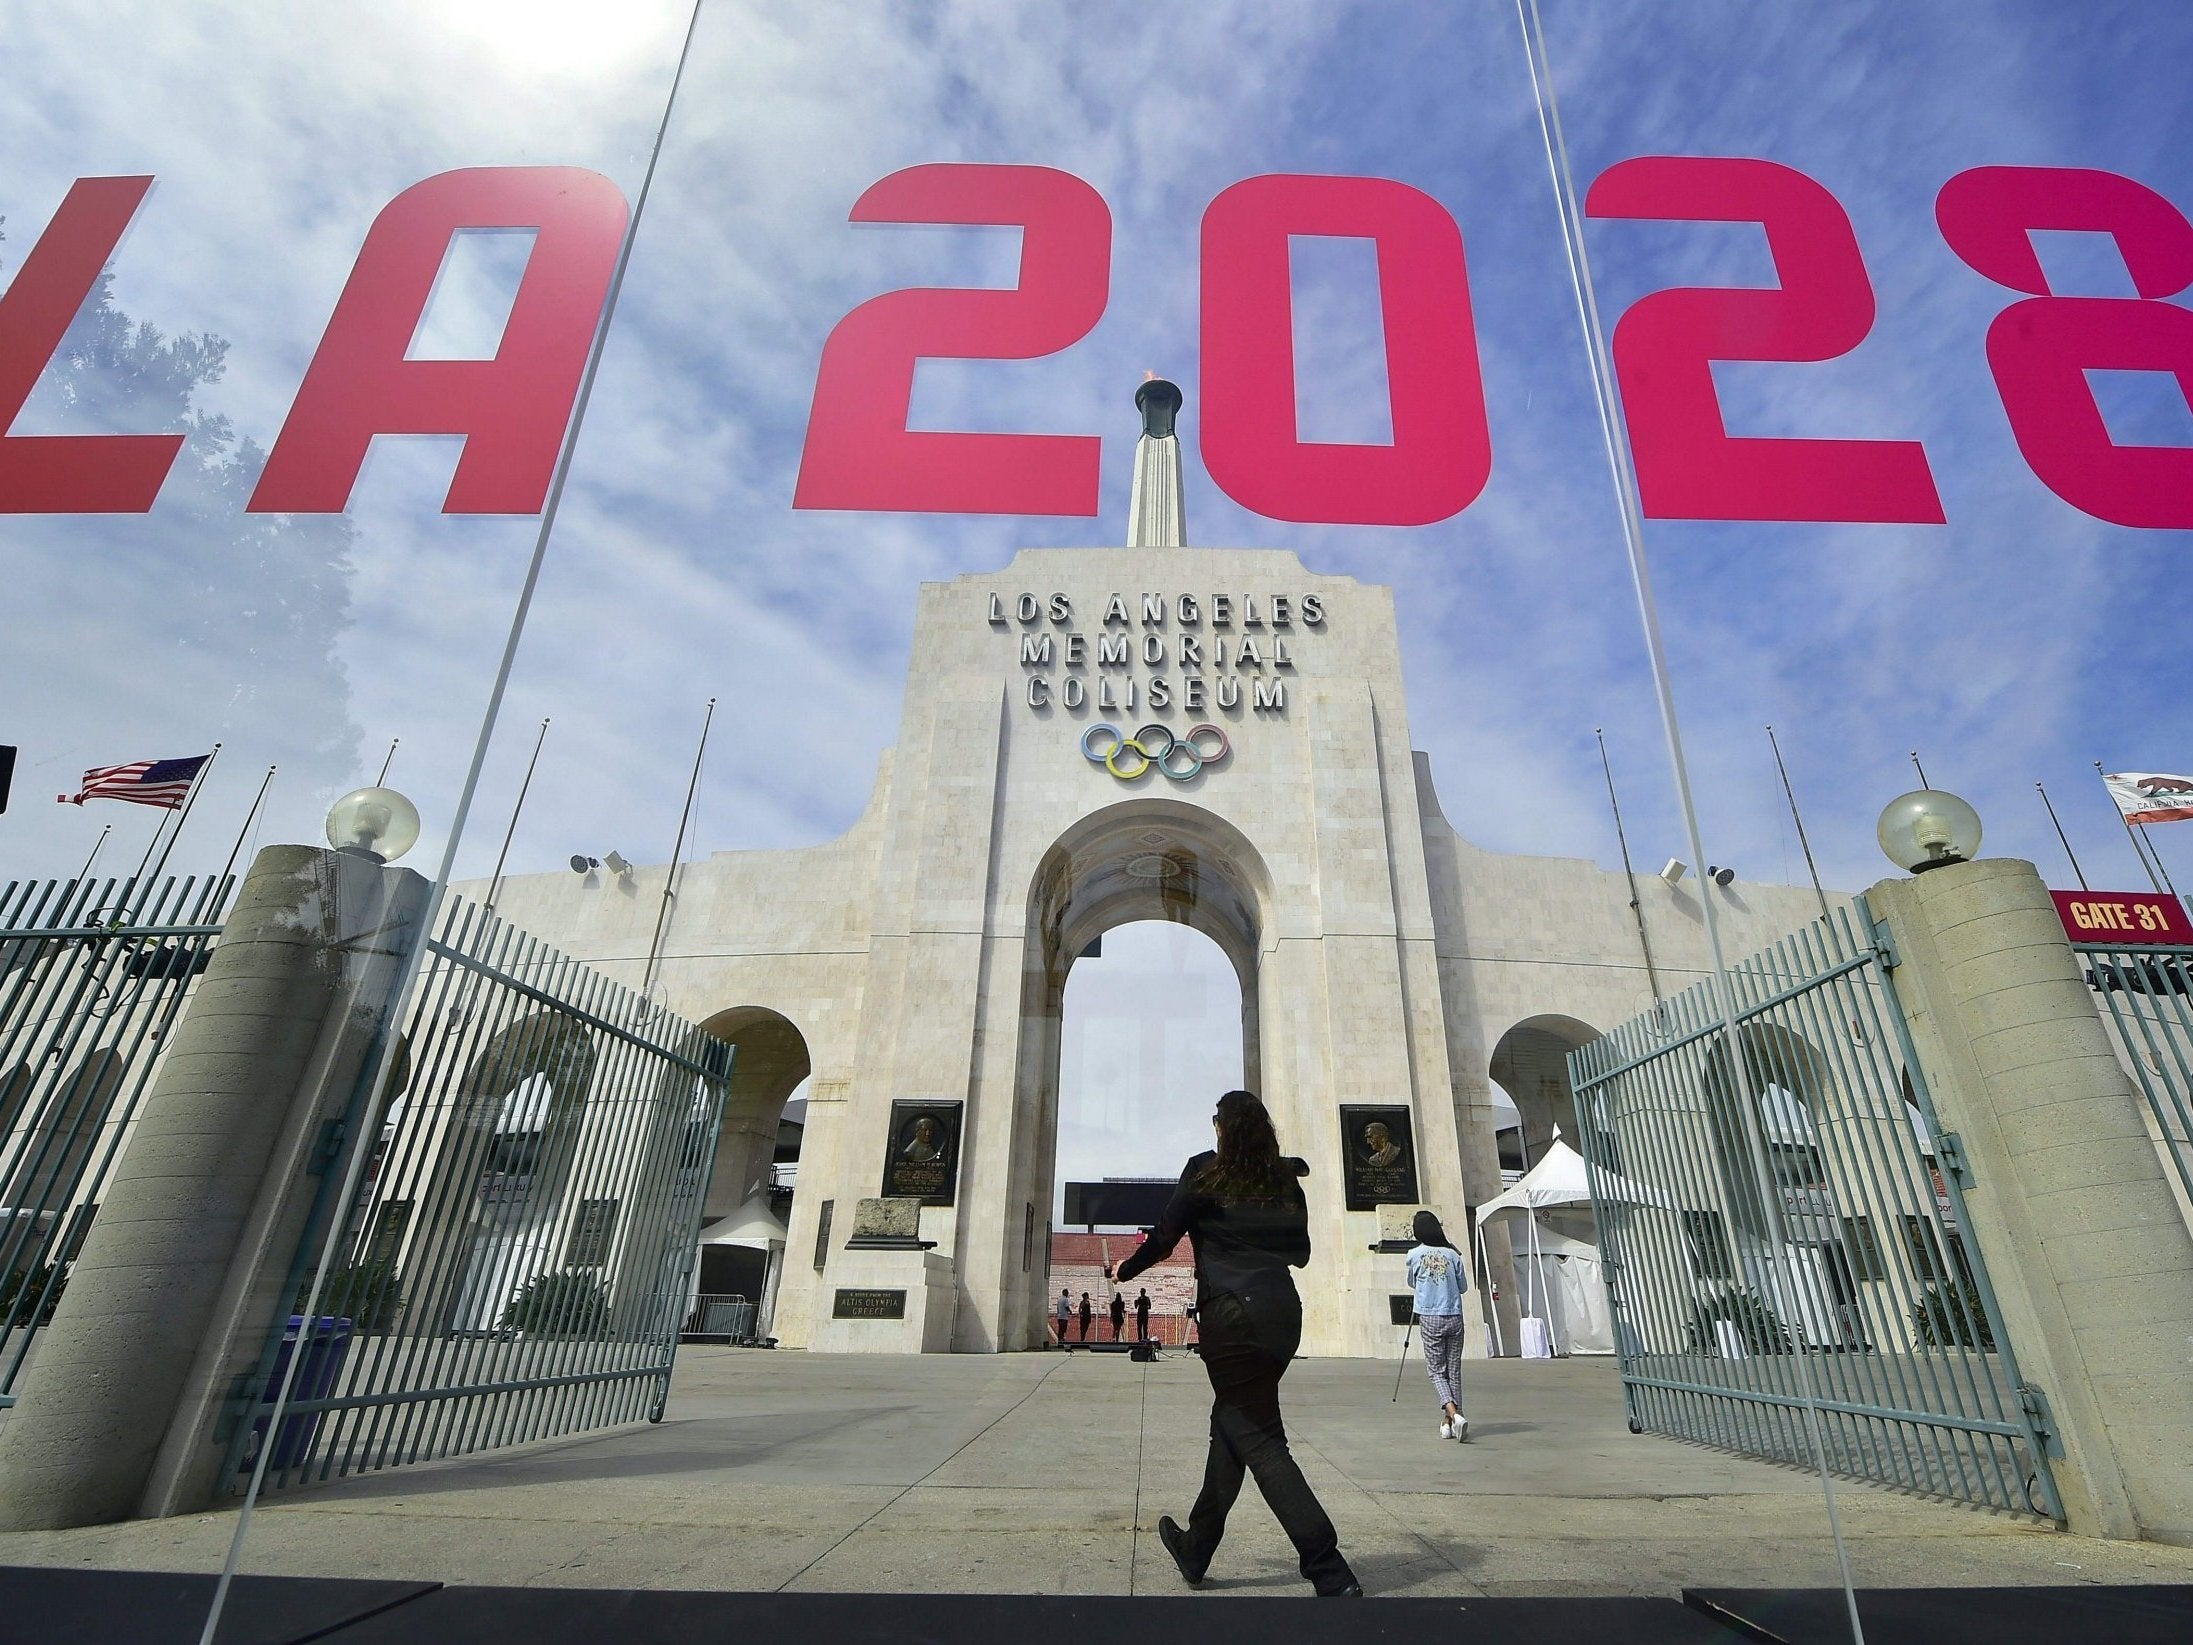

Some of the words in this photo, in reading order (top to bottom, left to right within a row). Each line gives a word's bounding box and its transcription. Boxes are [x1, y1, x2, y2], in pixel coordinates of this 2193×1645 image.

[0, 166, 629, 515] LA
[794, 157, 2193, 529] 2028
[987, 591, 1070, 626] LOS
[1102, 592, 1324, 627] ANGELES
[1020, 632, 1292, 667] MEMORIAL
[1026, 673, 1284, 712] COLISEUM
[2070, 901, 2136, 930] GATE
[2132, 903, 2170, 931] 31
[851, 1307, 885, 1317] GREECE
[865, 1299, 899, 1308] OLYMPIA
